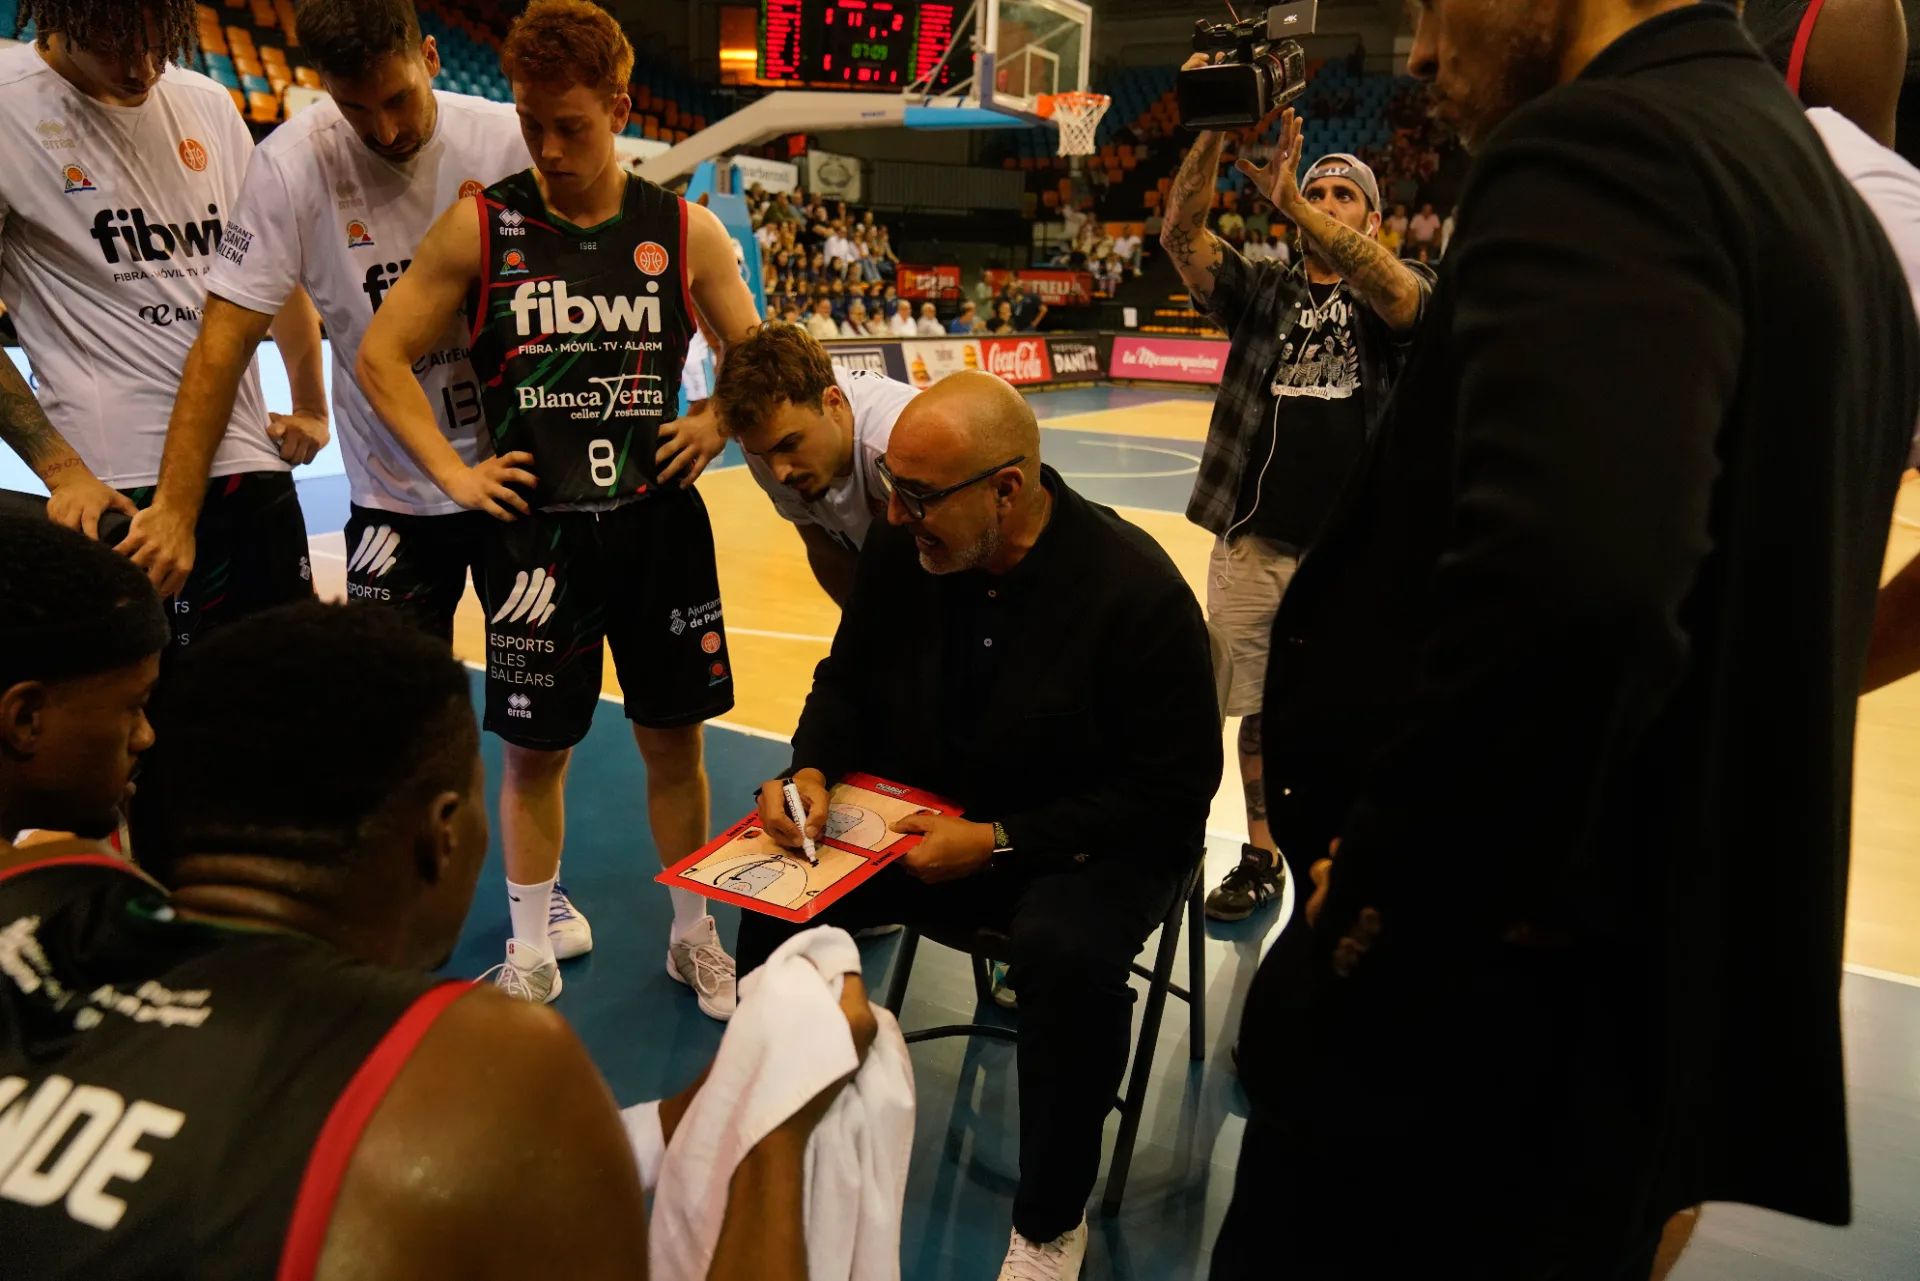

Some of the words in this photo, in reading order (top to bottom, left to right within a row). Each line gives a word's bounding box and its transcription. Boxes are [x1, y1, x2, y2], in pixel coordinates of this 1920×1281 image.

[90, 203, 223, 264] fibwi
[499, 226, 526, 236] errea
[579, 241, 598, 250] 1982
[113, 270, 149, 283] FIBRA
[510, 280, 662, 336] fibwi
[518, 344, 554, 355] FIBRA
[560, 341, 598, 353] MÓVIL
[603, 342, 618, 351] TV
[624, 341, 663, 351] ALARM
[441, 381, 482, 429] 13
[516, 385, 603, 409] Blanca
[588, 373, 664, 421] Terra
[570, 408, 601, 419] celler
[588, 439, 617, 487] 8
[690, 618, 703, 628] de
[490, 632, 555, 653] ESPORTS
[490, 665, 555, 688] BALEARS
[507, 707, 532, 719] errea
